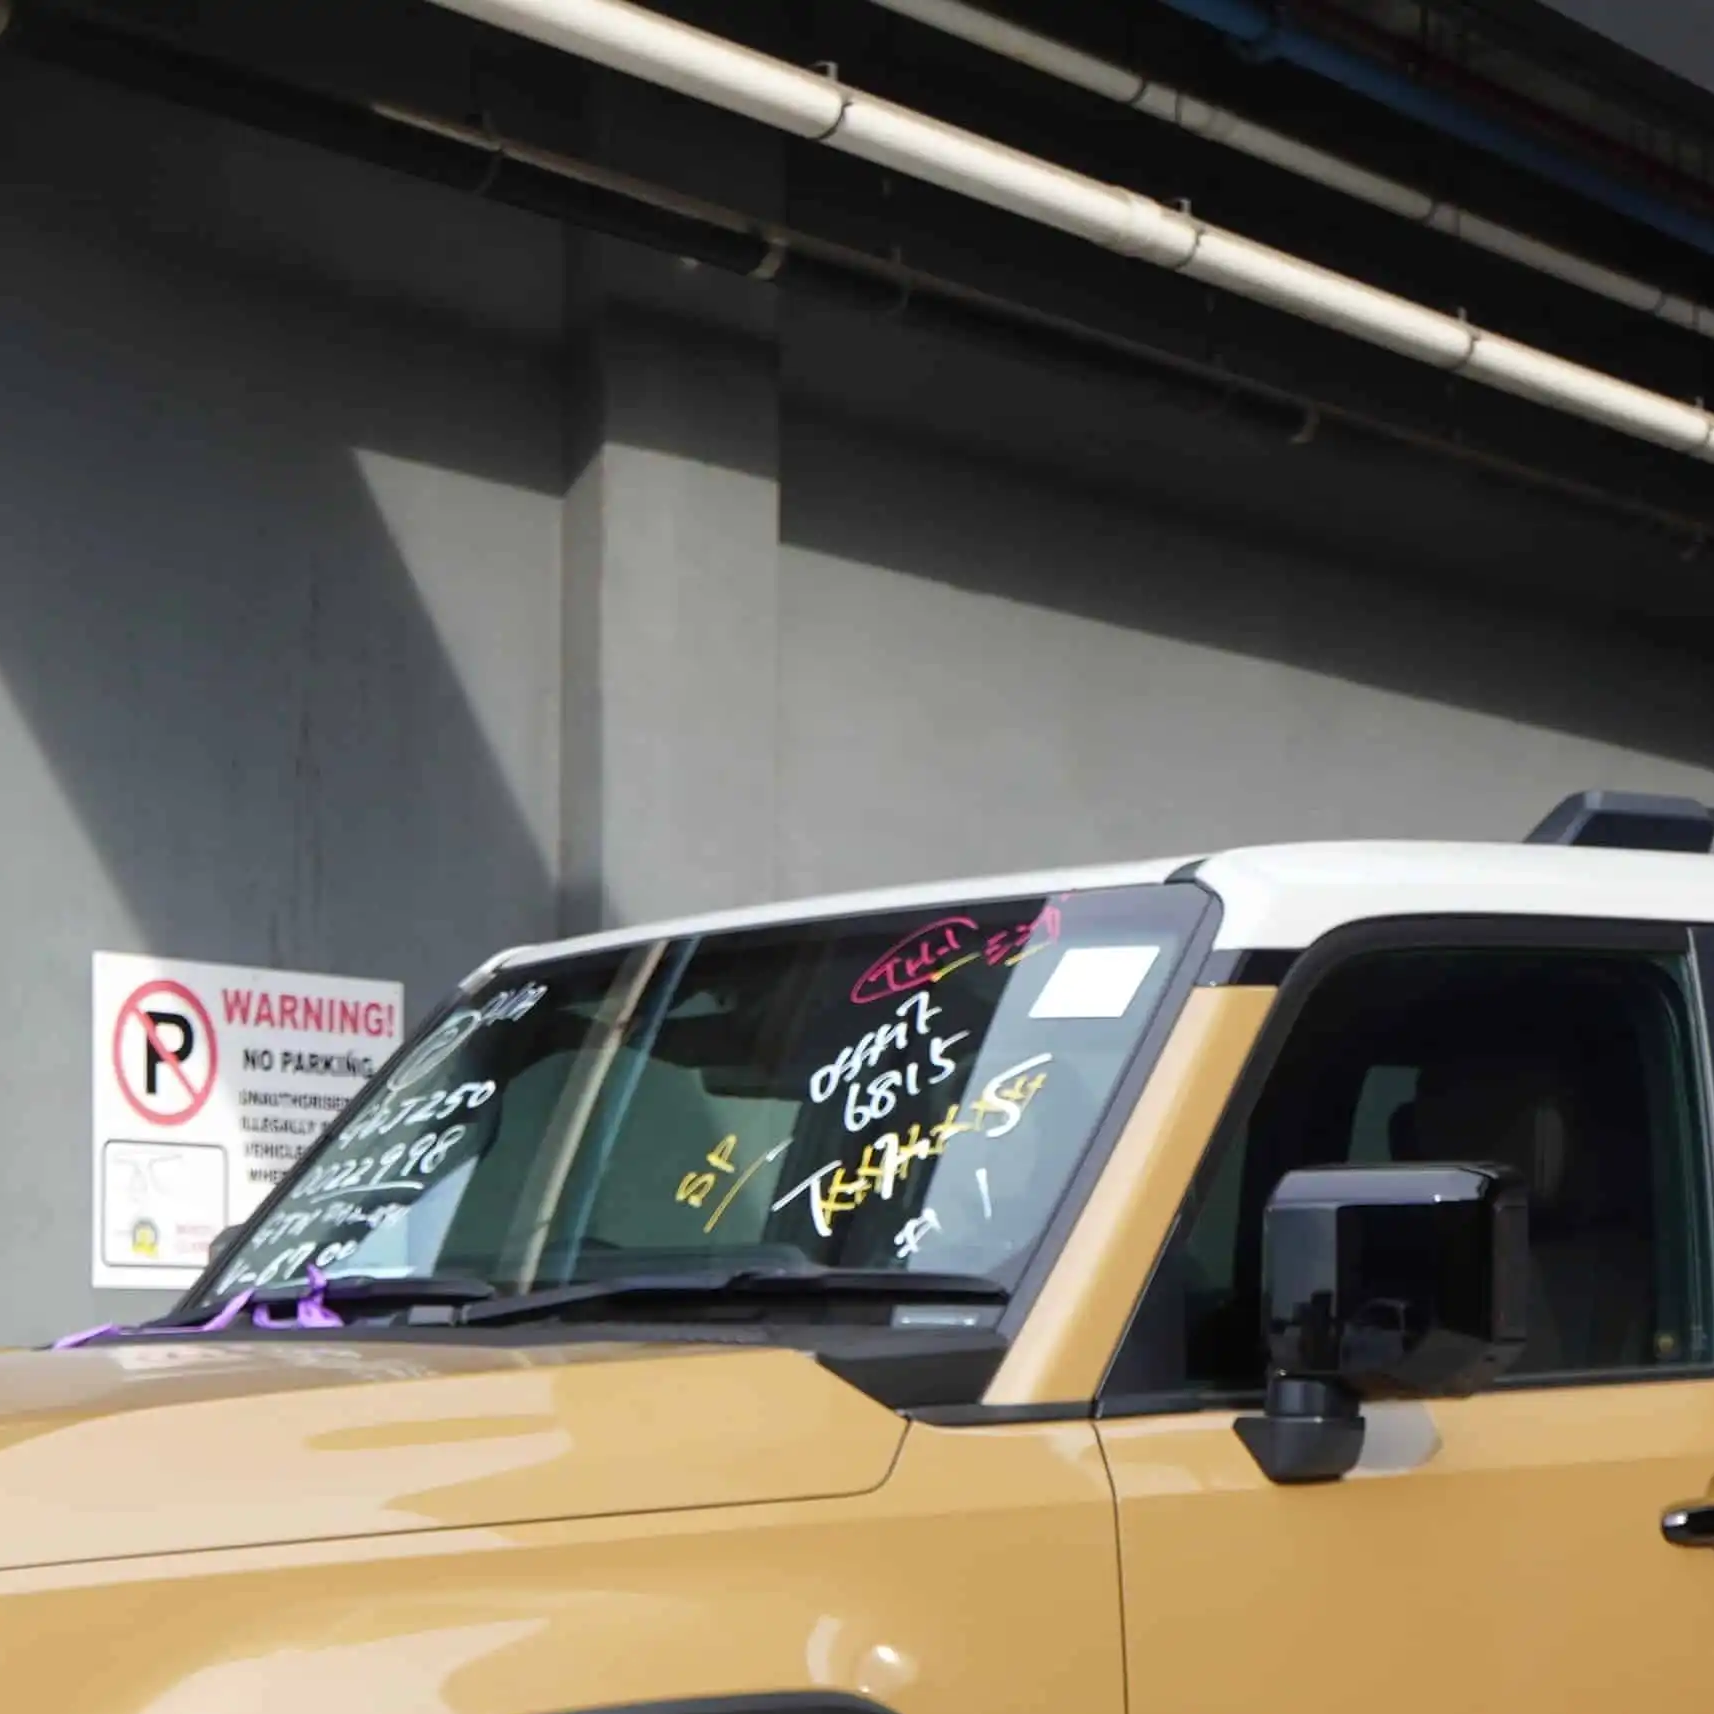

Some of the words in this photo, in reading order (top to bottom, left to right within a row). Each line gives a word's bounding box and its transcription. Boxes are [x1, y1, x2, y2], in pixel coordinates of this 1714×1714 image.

[222, 988, 394, 1038] WARNING!
[243, 1048, 273, 1072] NO
[280, 1050, 375, 1080] PARKING
